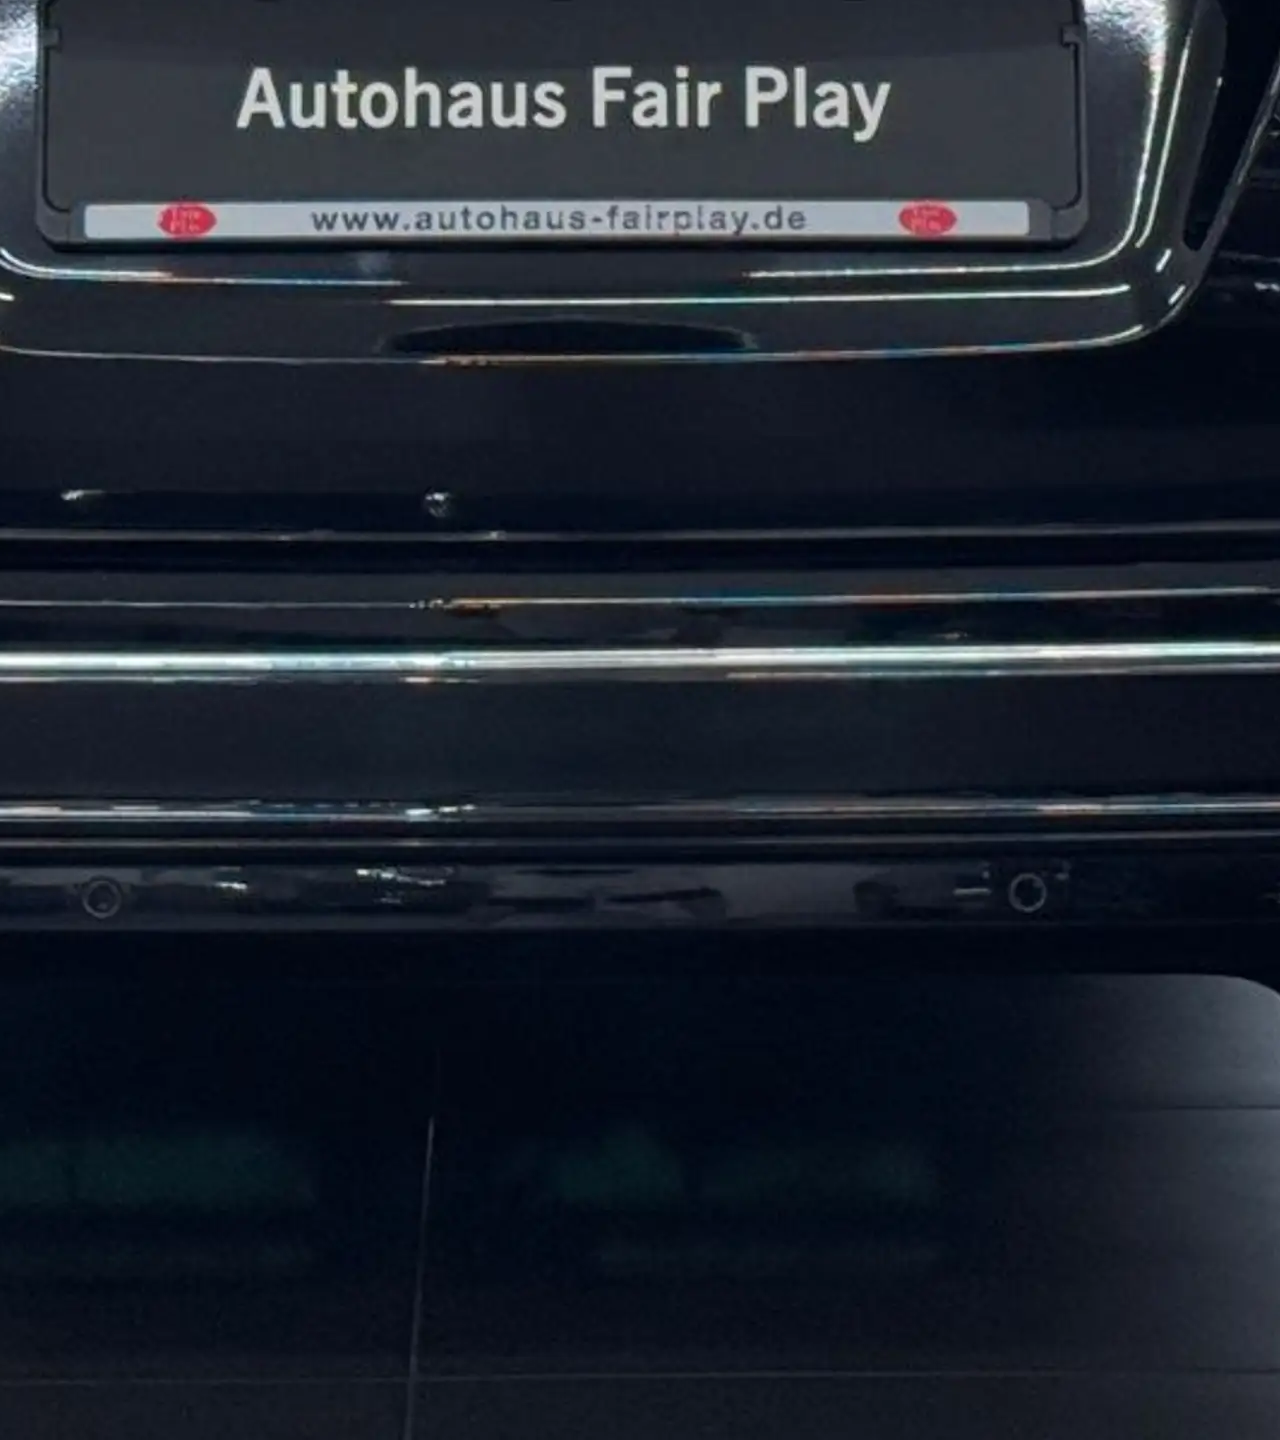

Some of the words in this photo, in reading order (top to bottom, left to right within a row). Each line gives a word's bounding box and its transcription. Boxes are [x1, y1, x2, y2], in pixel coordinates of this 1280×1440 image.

[235, 65, 568, 129] Autohaus
[592, 65, 723, 129] Fair
[744, 65, 892, 143] Play
[310, 203, 809, 237] www.autohaus-fairplay.de
